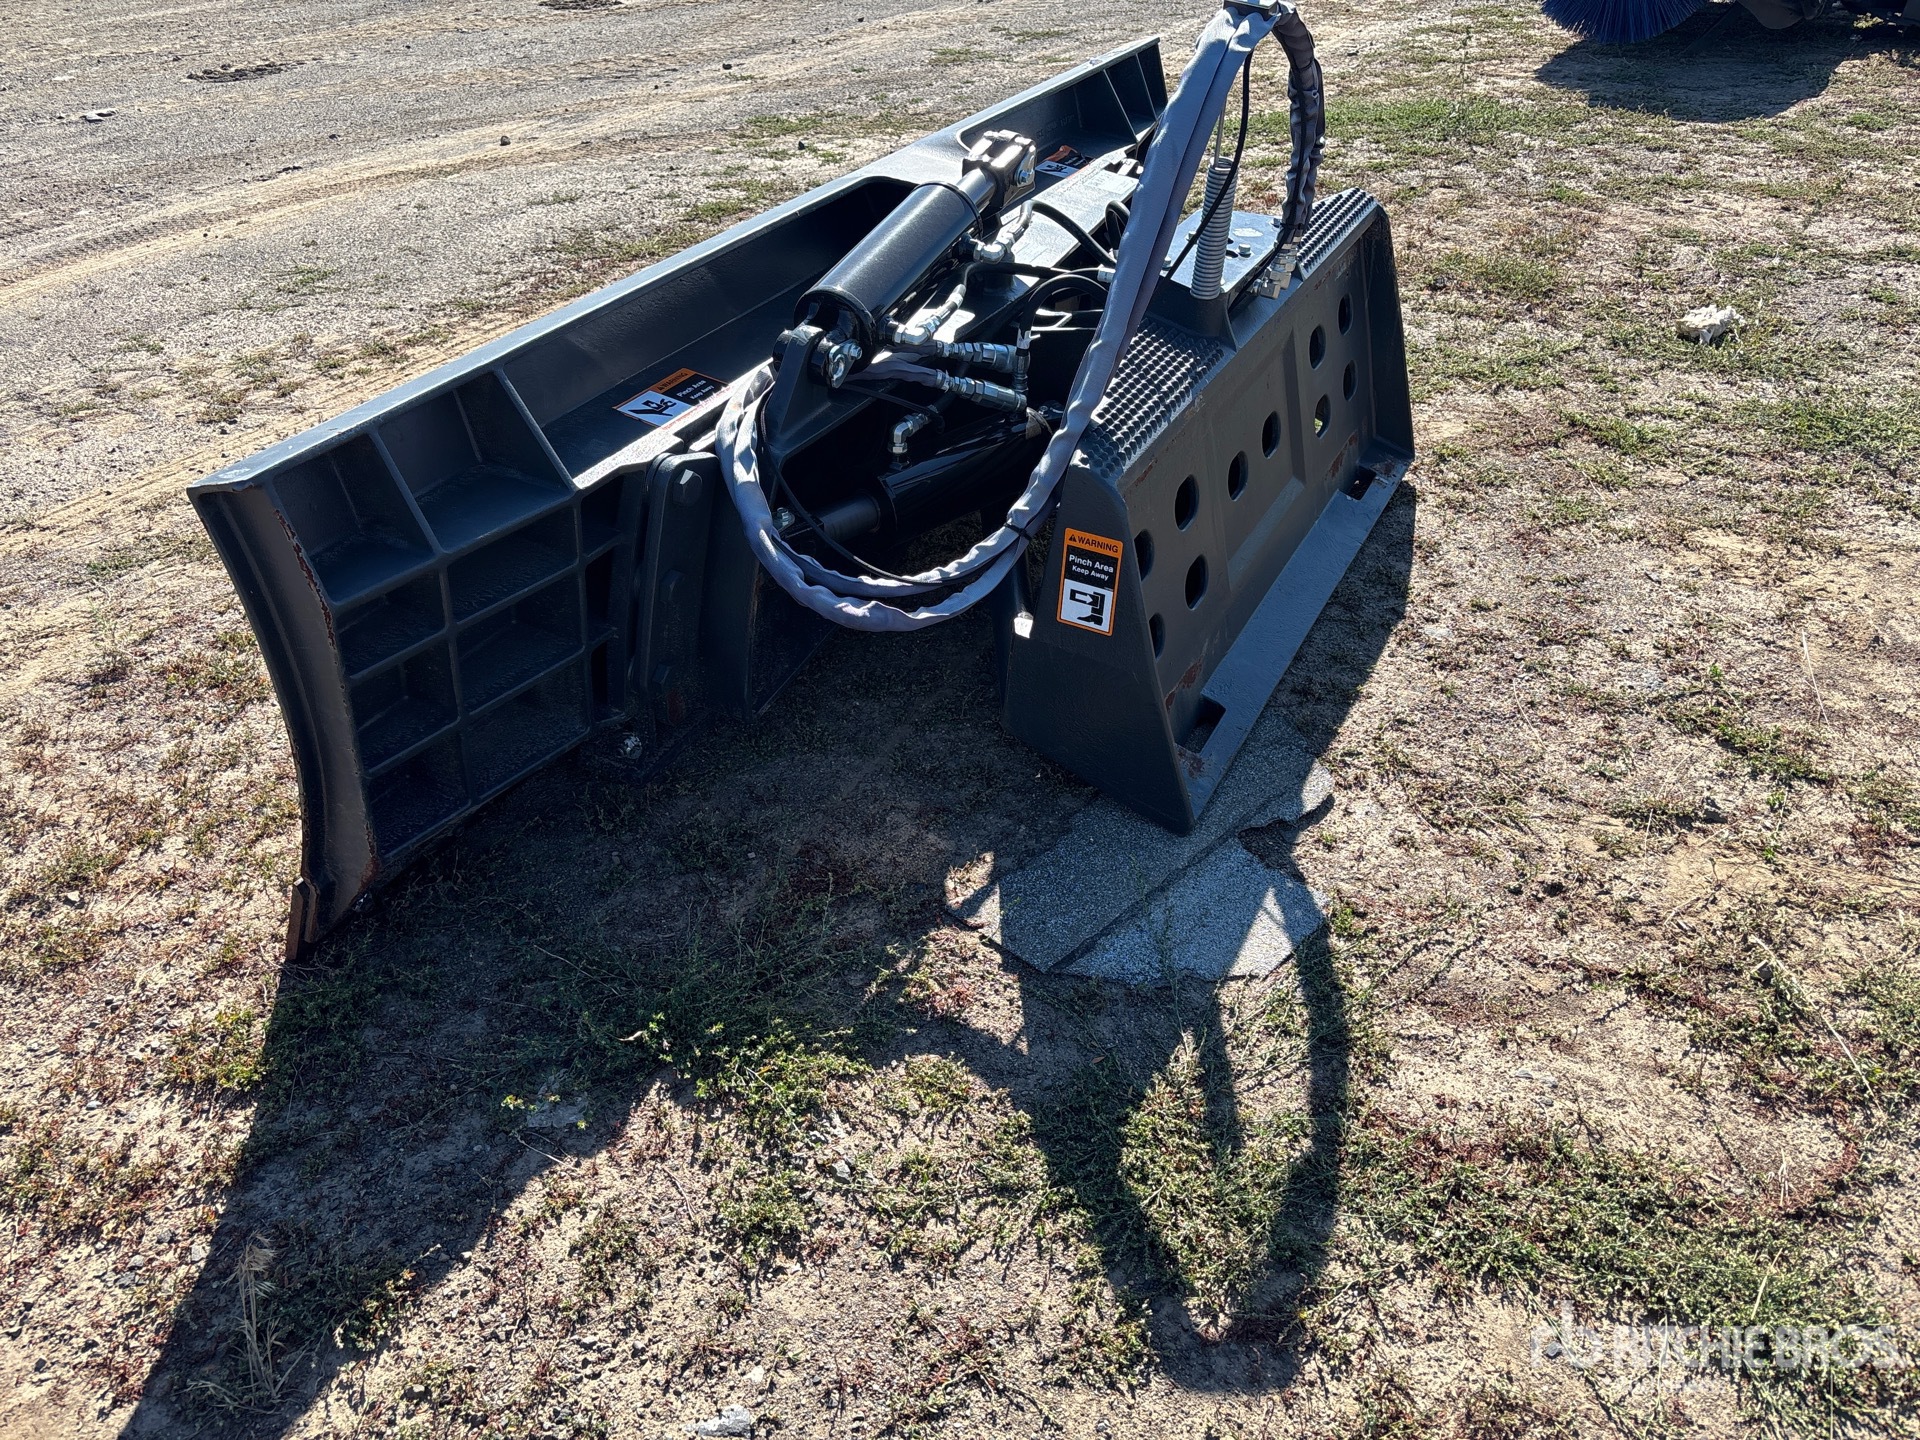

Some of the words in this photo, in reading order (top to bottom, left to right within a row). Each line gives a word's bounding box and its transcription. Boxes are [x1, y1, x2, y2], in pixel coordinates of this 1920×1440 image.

[1077, 535, 1119, 553] WARNING
[1068, 554, 1093, 567] Pinch
[1094, 561, 1114, 573] Area
[1072, 565, 1090, 576] Keep
[1090, 570, 1109, 581] Away
